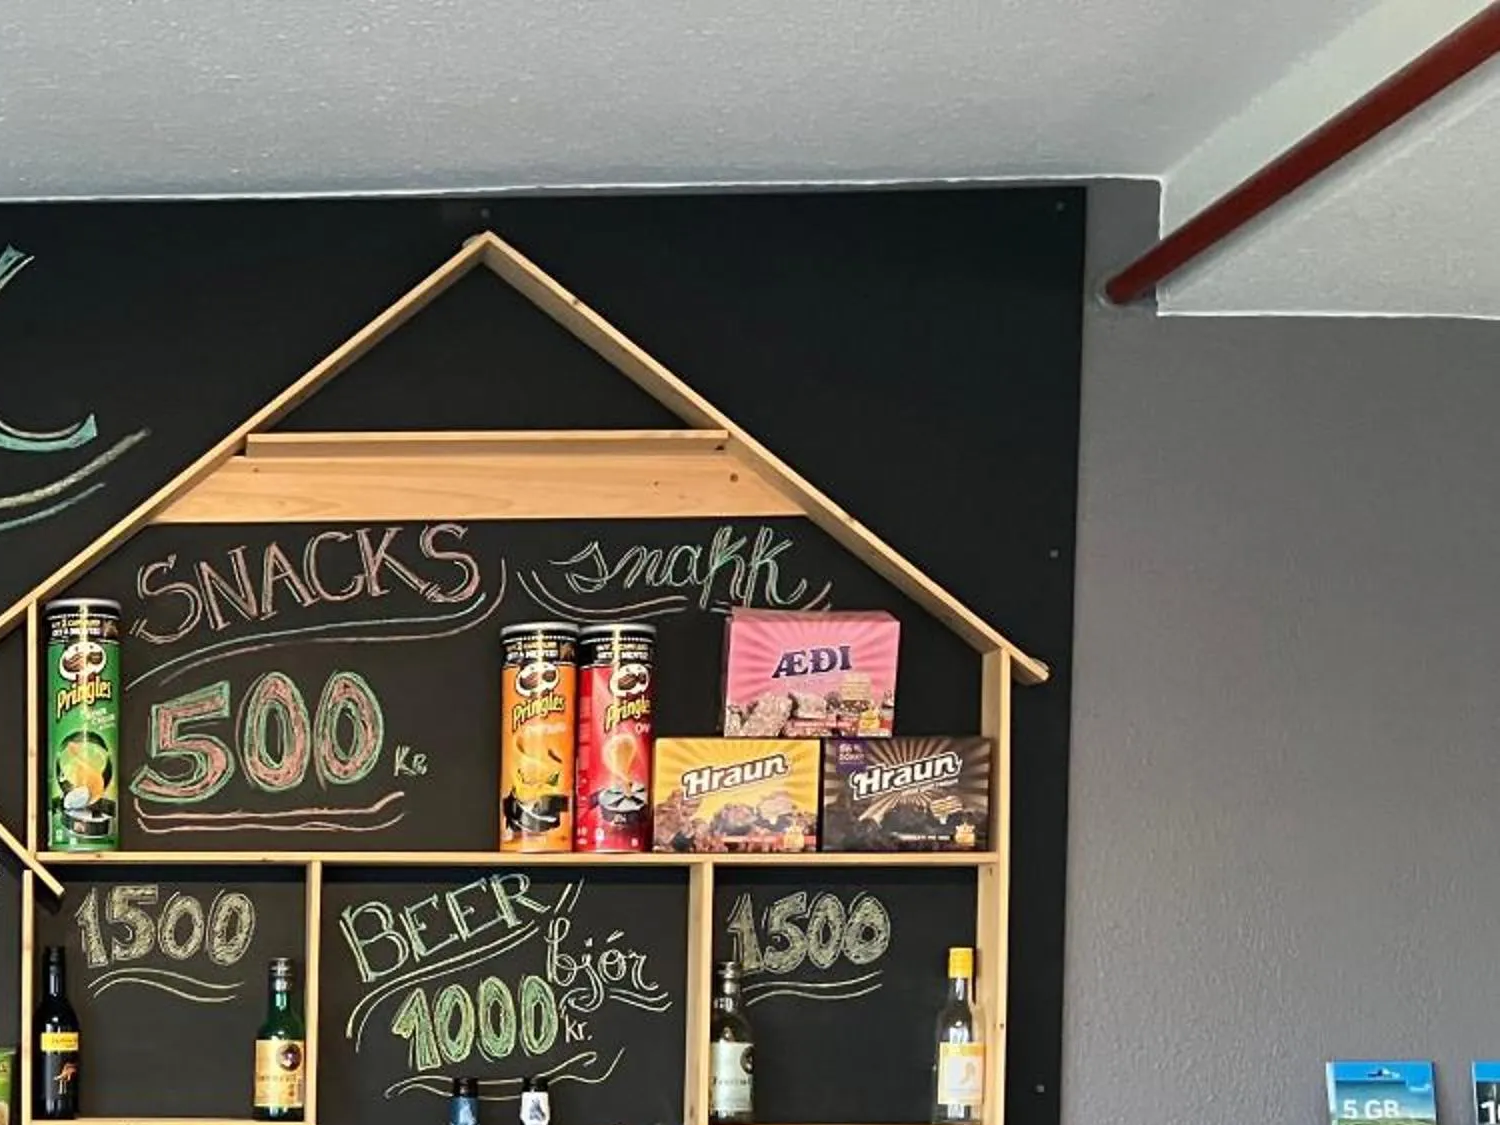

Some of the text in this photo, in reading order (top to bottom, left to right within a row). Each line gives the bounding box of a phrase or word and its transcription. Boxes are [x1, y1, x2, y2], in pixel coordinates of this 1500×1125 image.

[129, 523, 482, 645] SNACKS
[56, 678, 112, 719] Pringles
[512, 695, 566, 733] Pringles
[129, 671, 385, 804] 500
[682, 752, 790, 801] Hraun
[850, 752, 963, 801] Hraun
[74, 882, 257, 969] 1500
[339, 872, 552, 984] BEER
[726, 890, 892, 977] 1500
[391, 975, 560, 1071] 1000
[1344, 1099, 1400, 1119] 5 GB
[1481, 1101, 1500, 1125] 1
